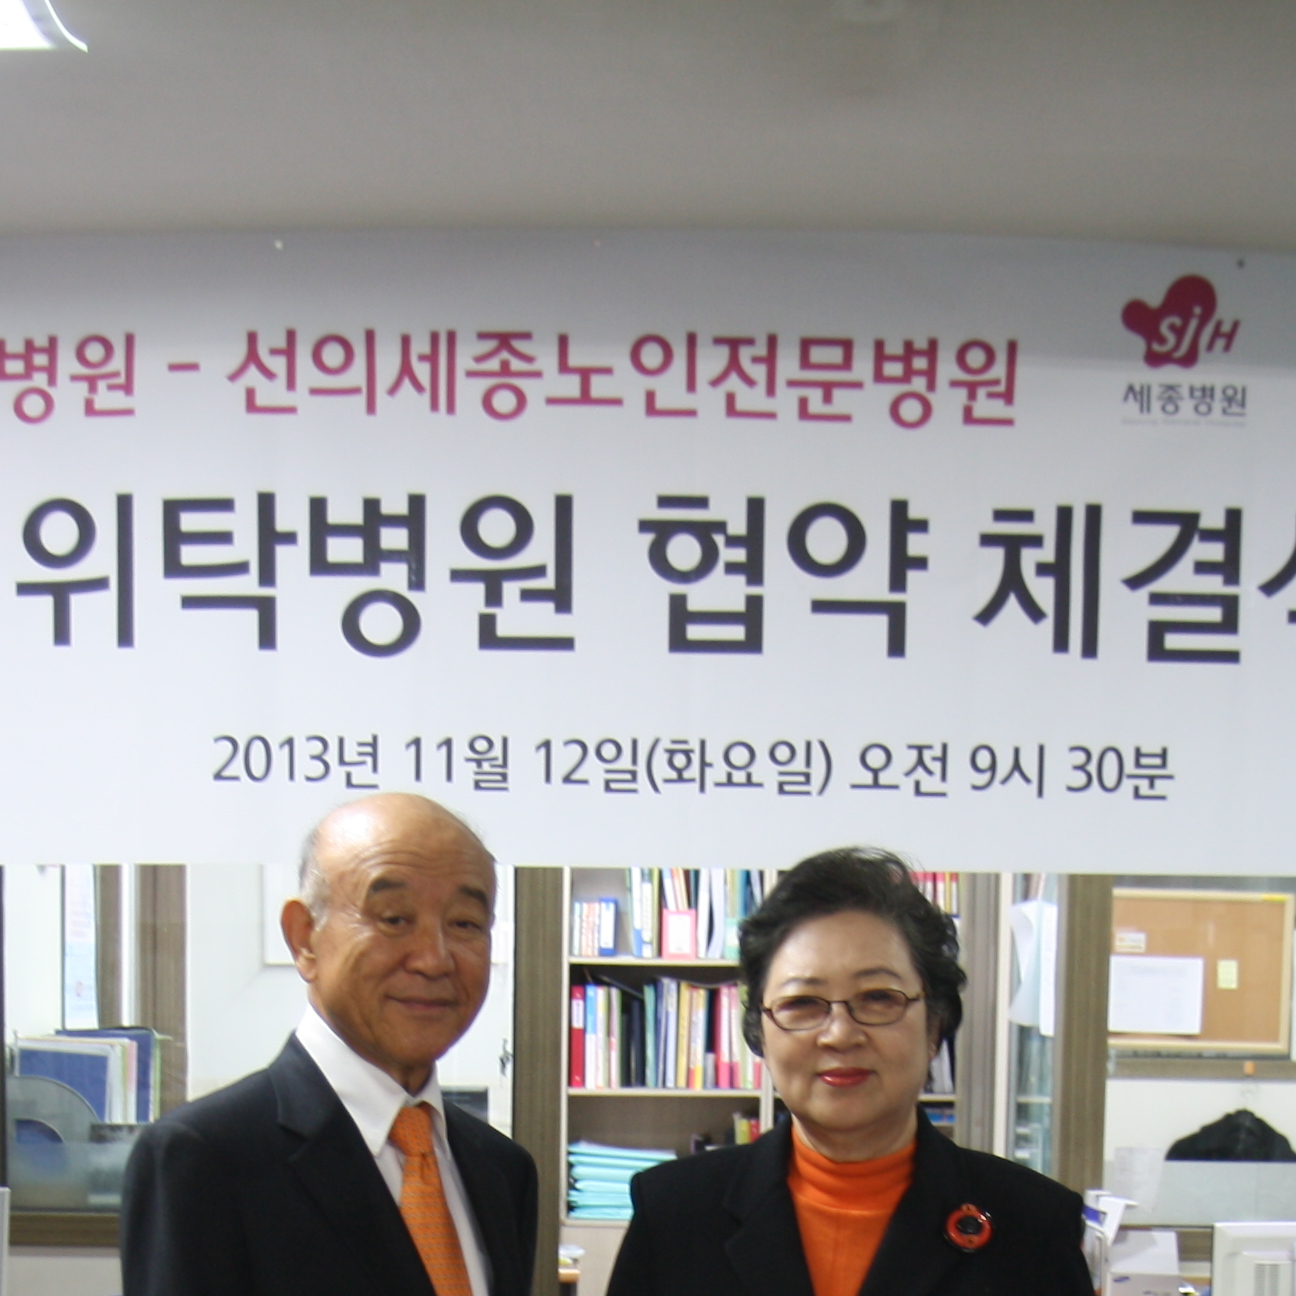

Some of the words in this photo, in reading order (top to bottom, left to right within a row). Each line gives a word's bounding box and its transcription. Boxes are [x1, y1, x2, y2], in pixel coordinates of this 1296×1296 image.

[226, 327, 1020, 430] 선의세종노인전문병원
[1122, 382, 1248, 417] 세종병원
[16, 491, 576, 658] 위탁병원
[638, 494, 930, 659] 협약
[212, 733, 380, 790] 2013년
[404, 734, 510, 792] 11월
[534, 737, 833, 797] 12일(화요일)
[849, 741, 950, 798] 오전
[969, 743, 1046, 800] 9시
[1065, 744, 1176, 801] 30분
